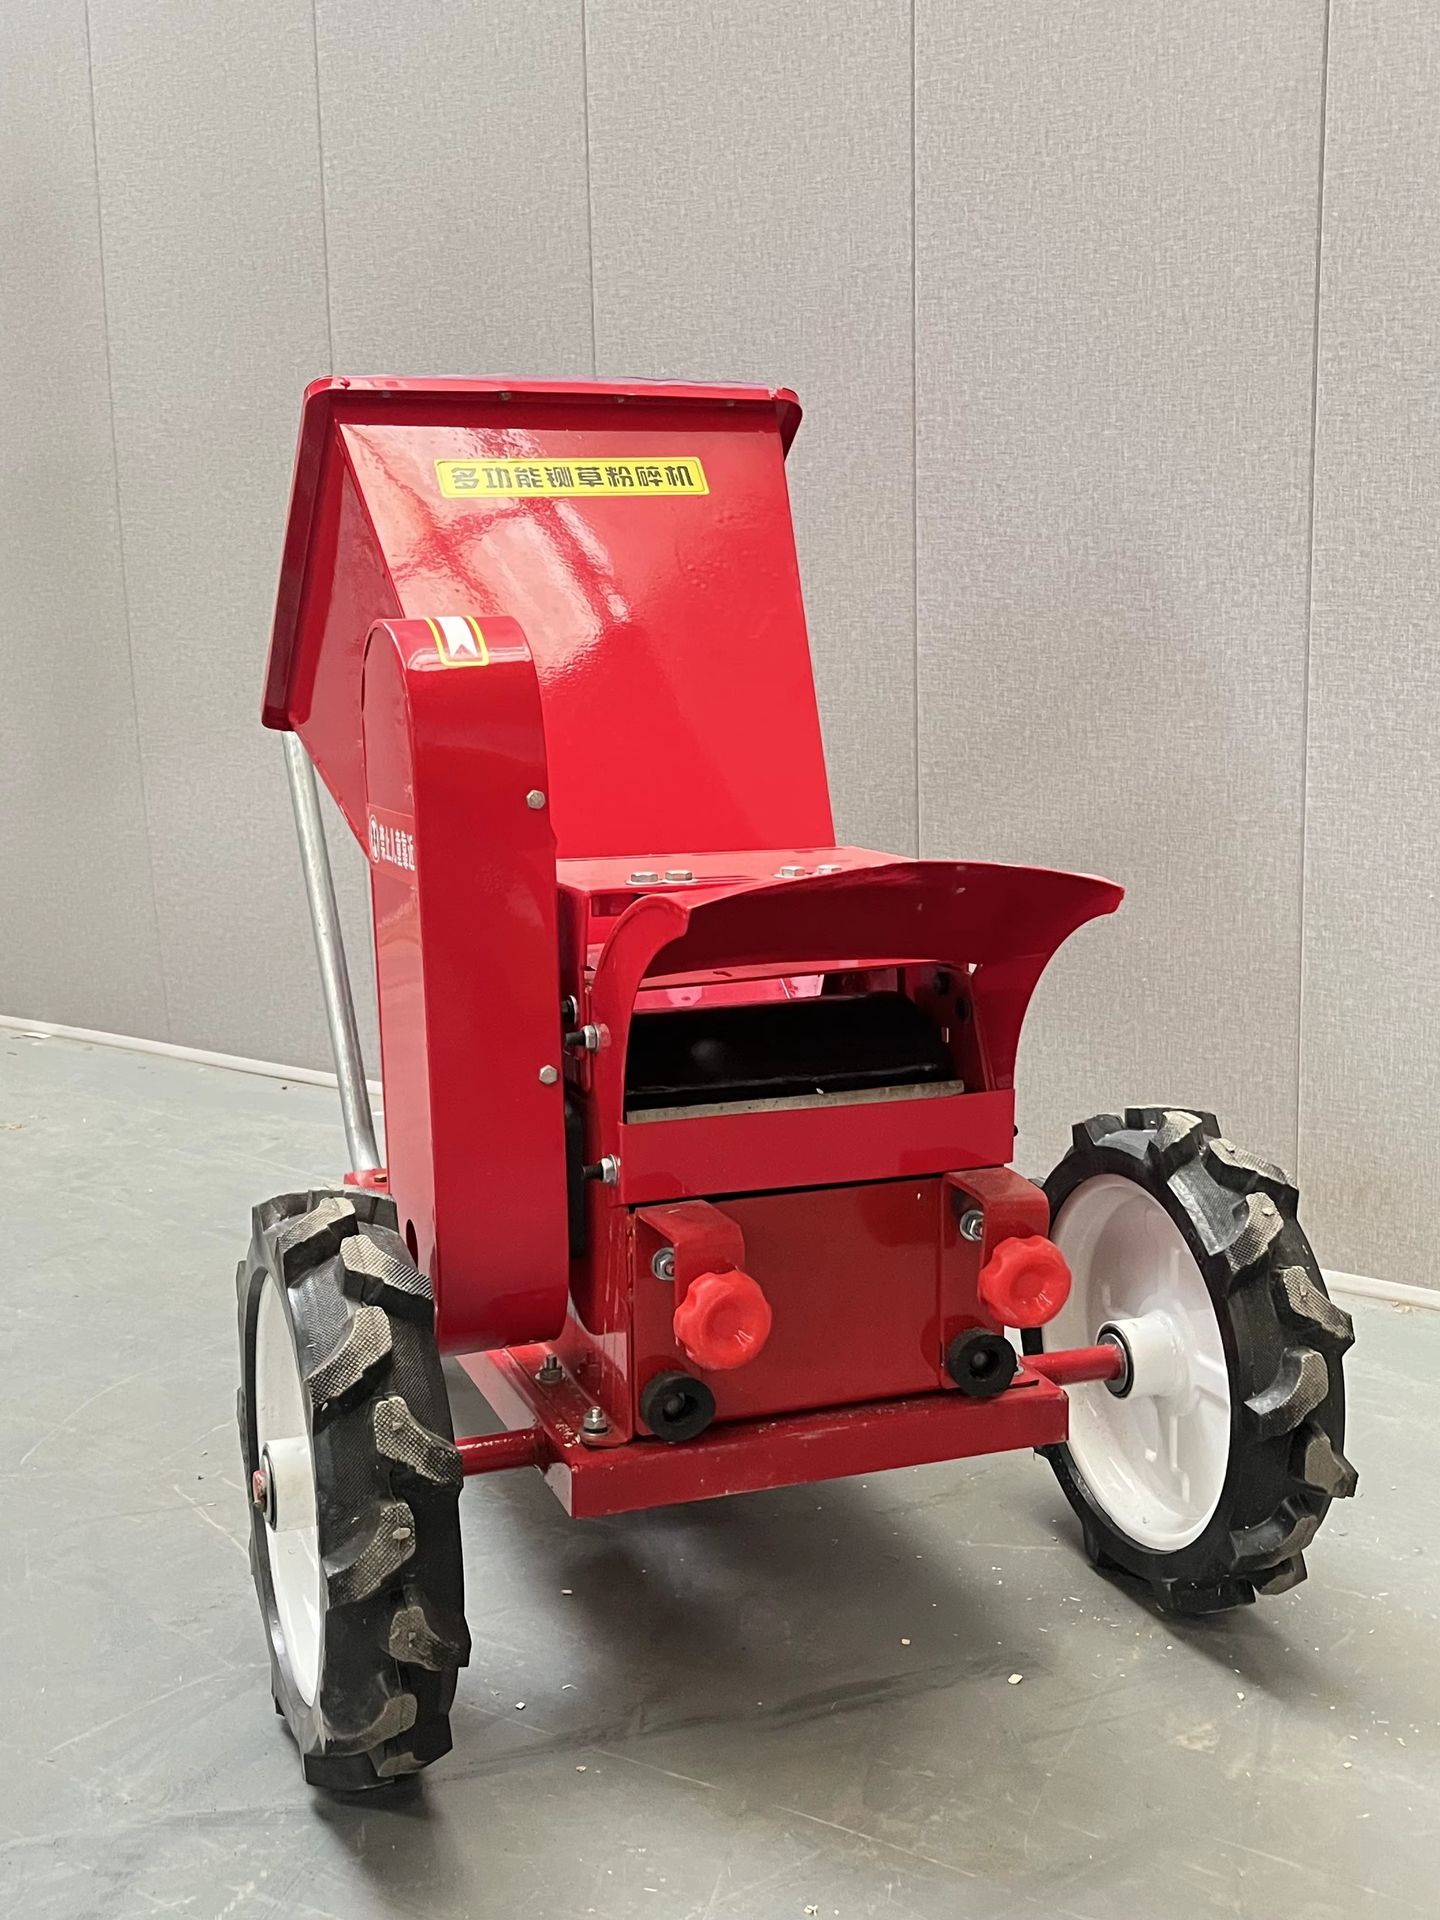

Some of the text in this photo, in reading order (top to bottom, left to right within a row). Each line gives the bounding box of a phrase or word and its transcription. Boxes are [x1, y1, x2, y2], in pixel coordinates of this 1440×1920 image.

[452, 465, 694, 489] 多功能铡草粉碎机
